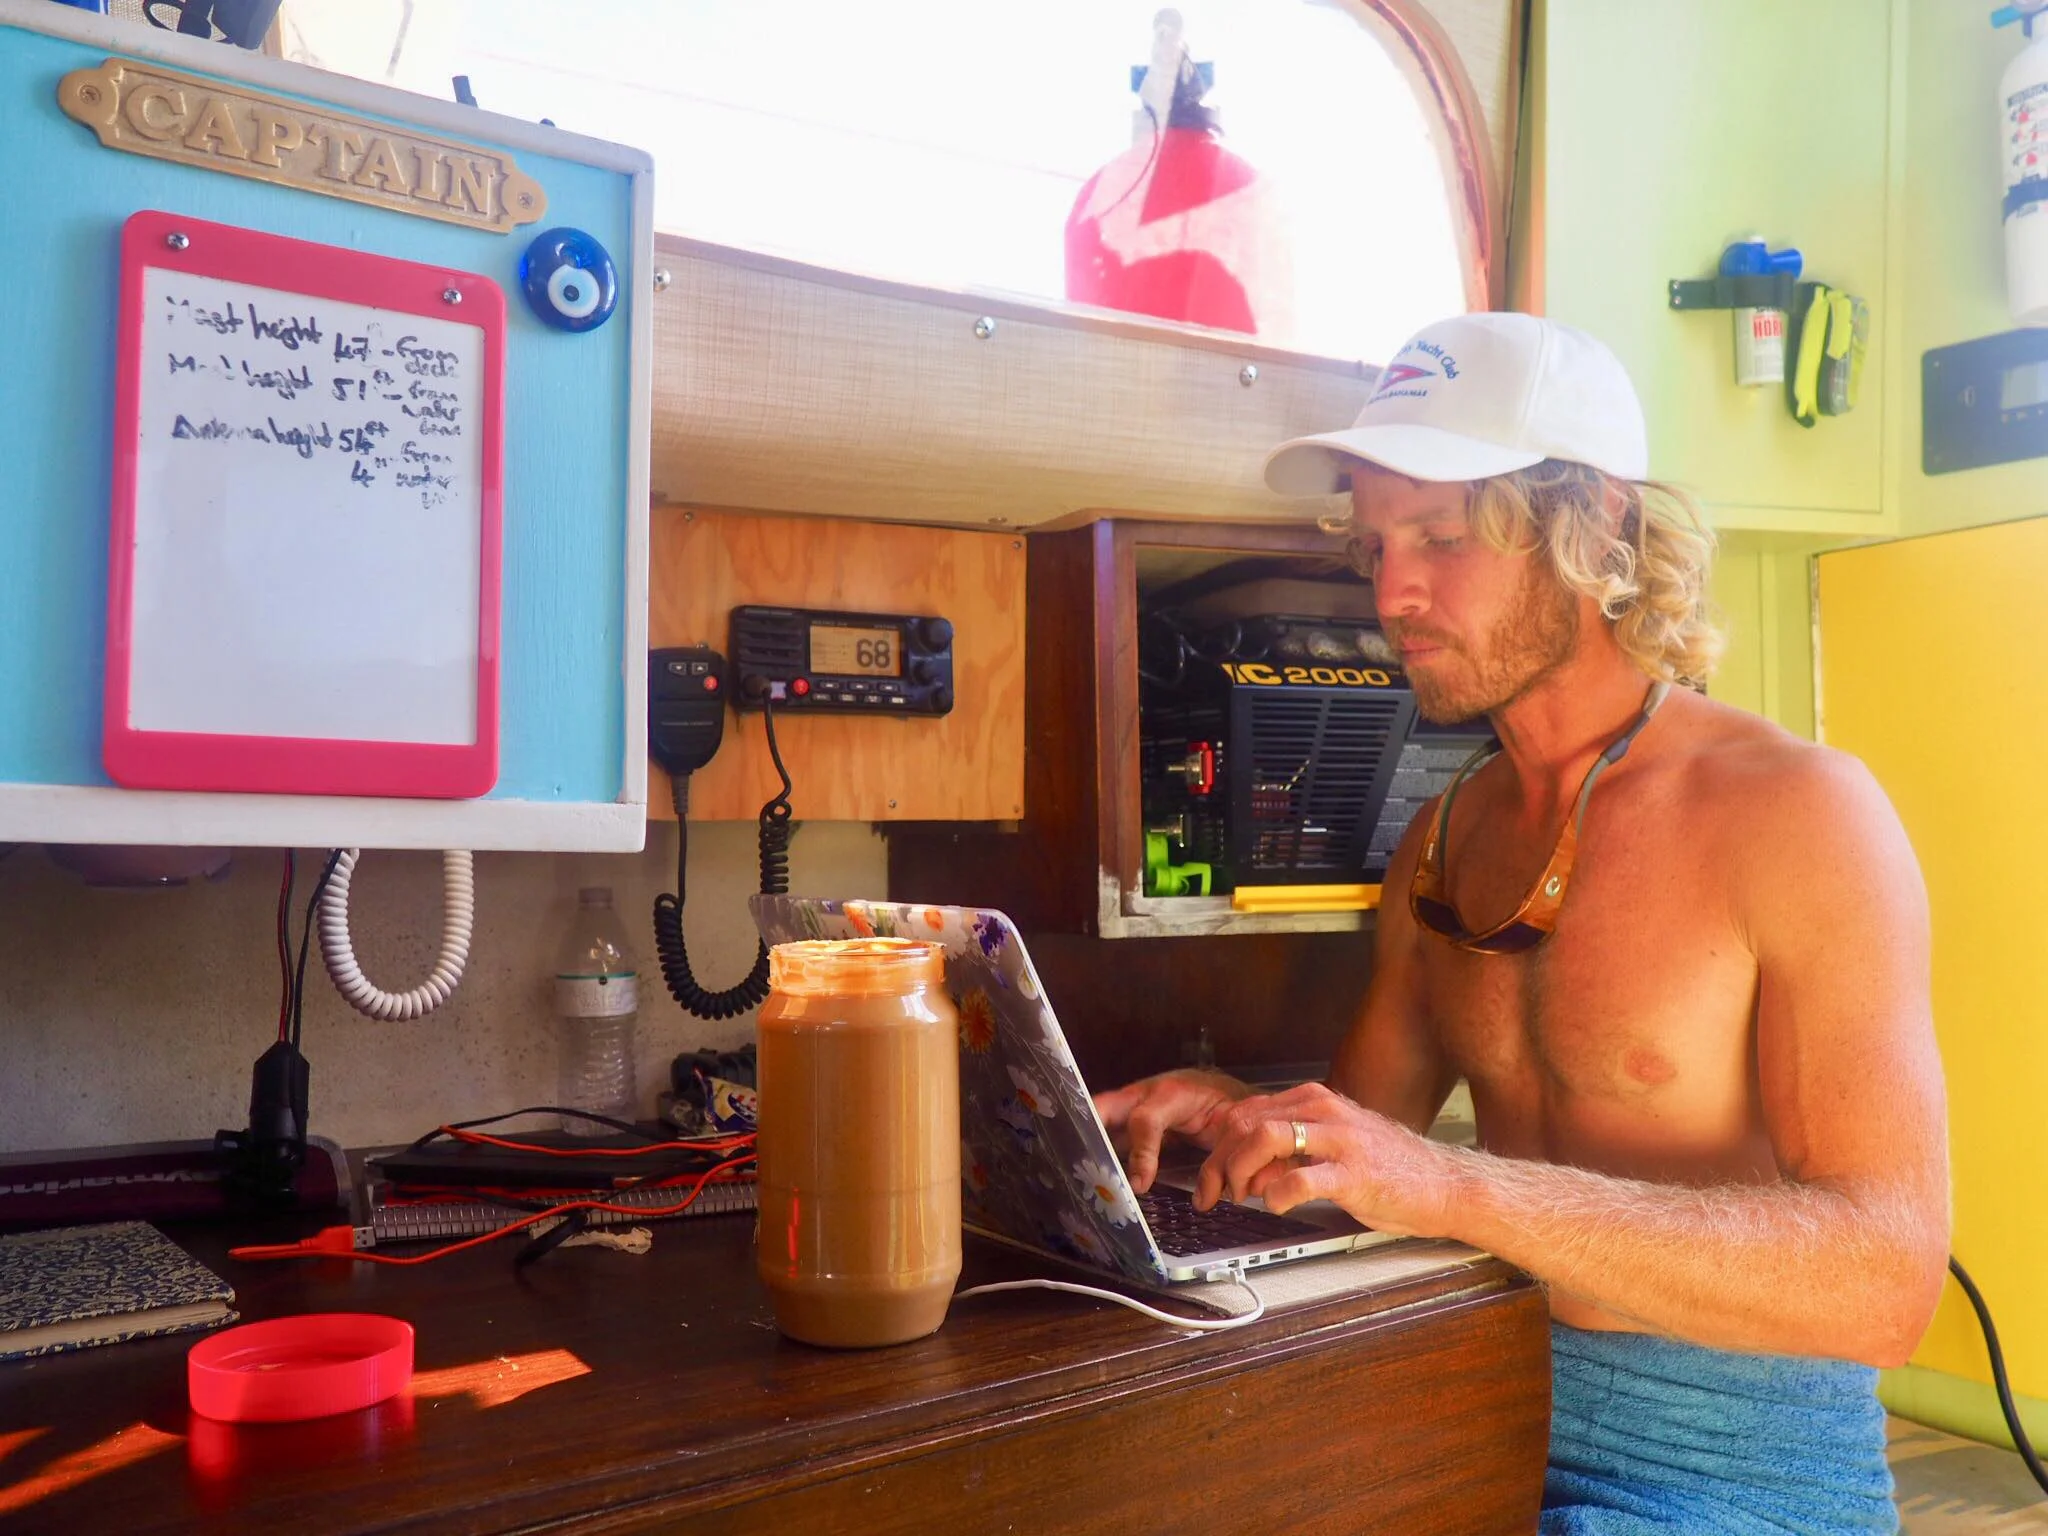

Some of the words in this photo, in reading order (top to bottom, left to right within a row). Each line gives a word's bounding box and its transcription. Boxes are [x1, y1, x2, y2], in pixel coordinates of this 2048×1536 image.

[125, 83, 497, 217] CAPTAIN
[248, 303, 322, 350] height
[856, 639, 890, 668] 68
[1283, 667, 1391, 686] 2000
[0, 1170, 222, 1195] aymarin
